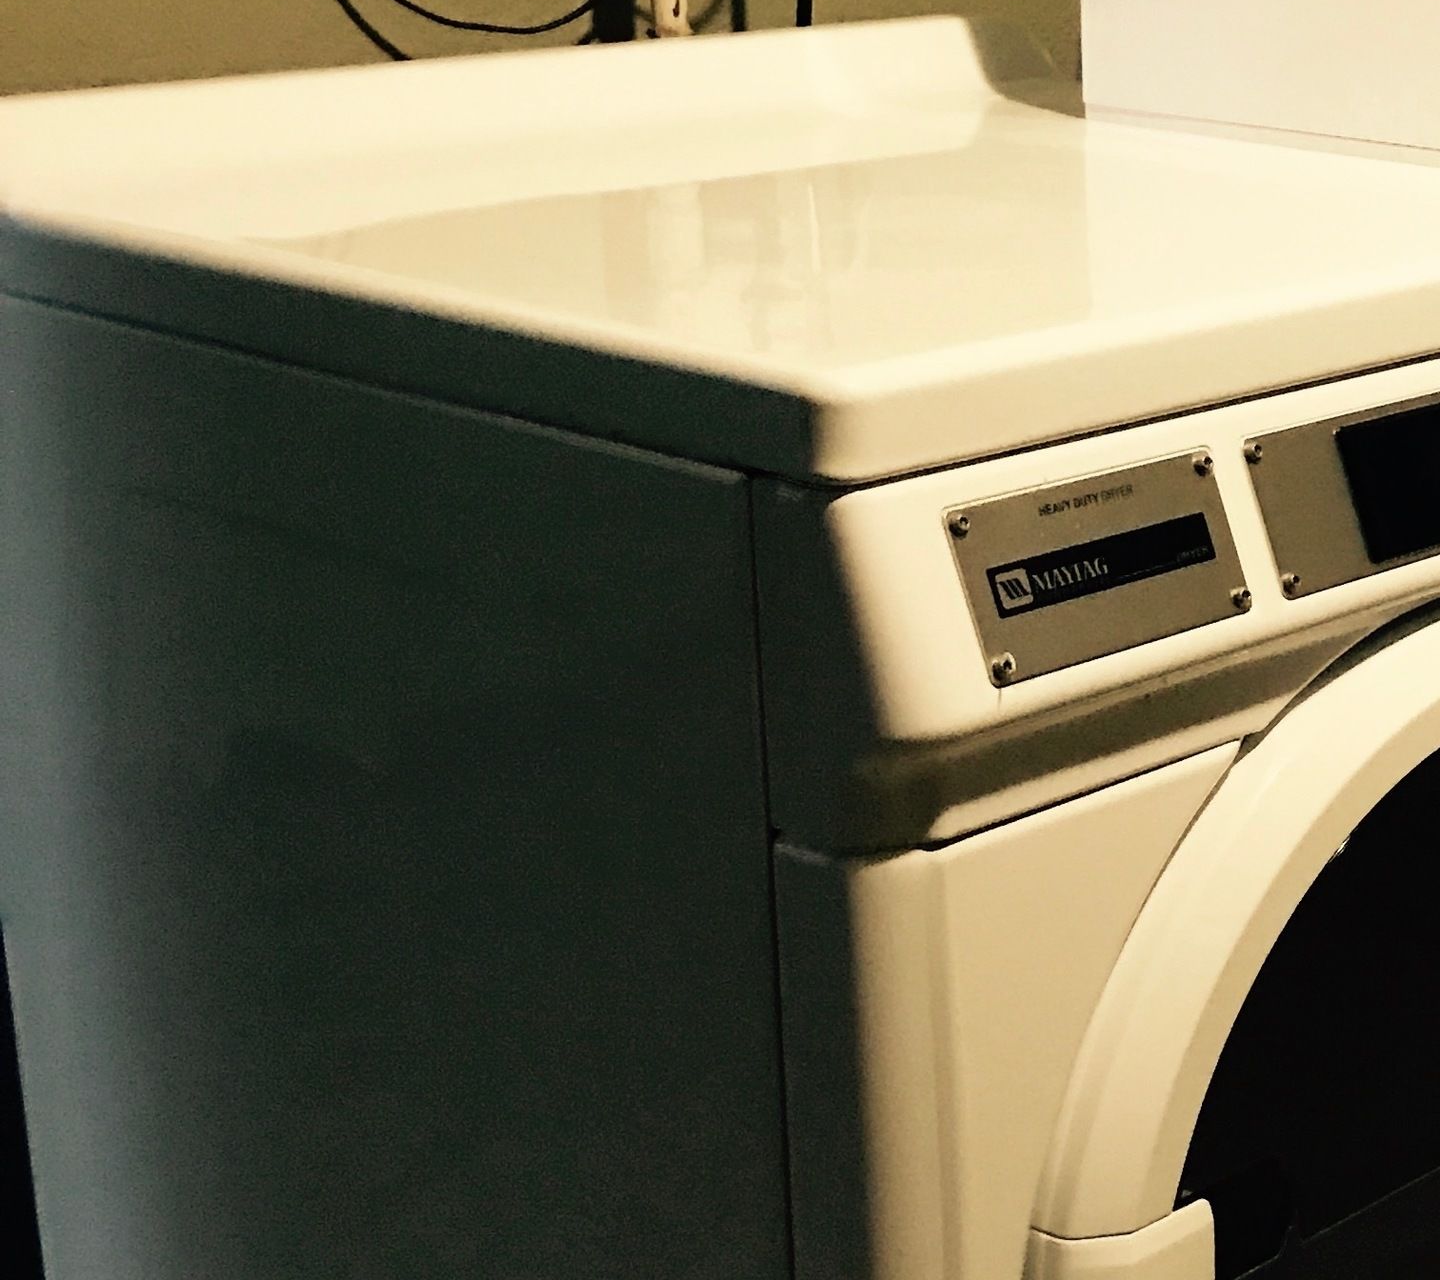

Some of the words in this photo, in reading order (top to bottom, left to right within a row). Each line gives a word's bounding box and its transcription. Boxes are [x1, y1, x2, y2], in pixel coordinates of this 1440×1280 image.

[1038, 500, 1071, 517] HEAVY
[1073, 493, 1099, 510] DUTY
[1031, 556, 1109, 592] MAYTAG
